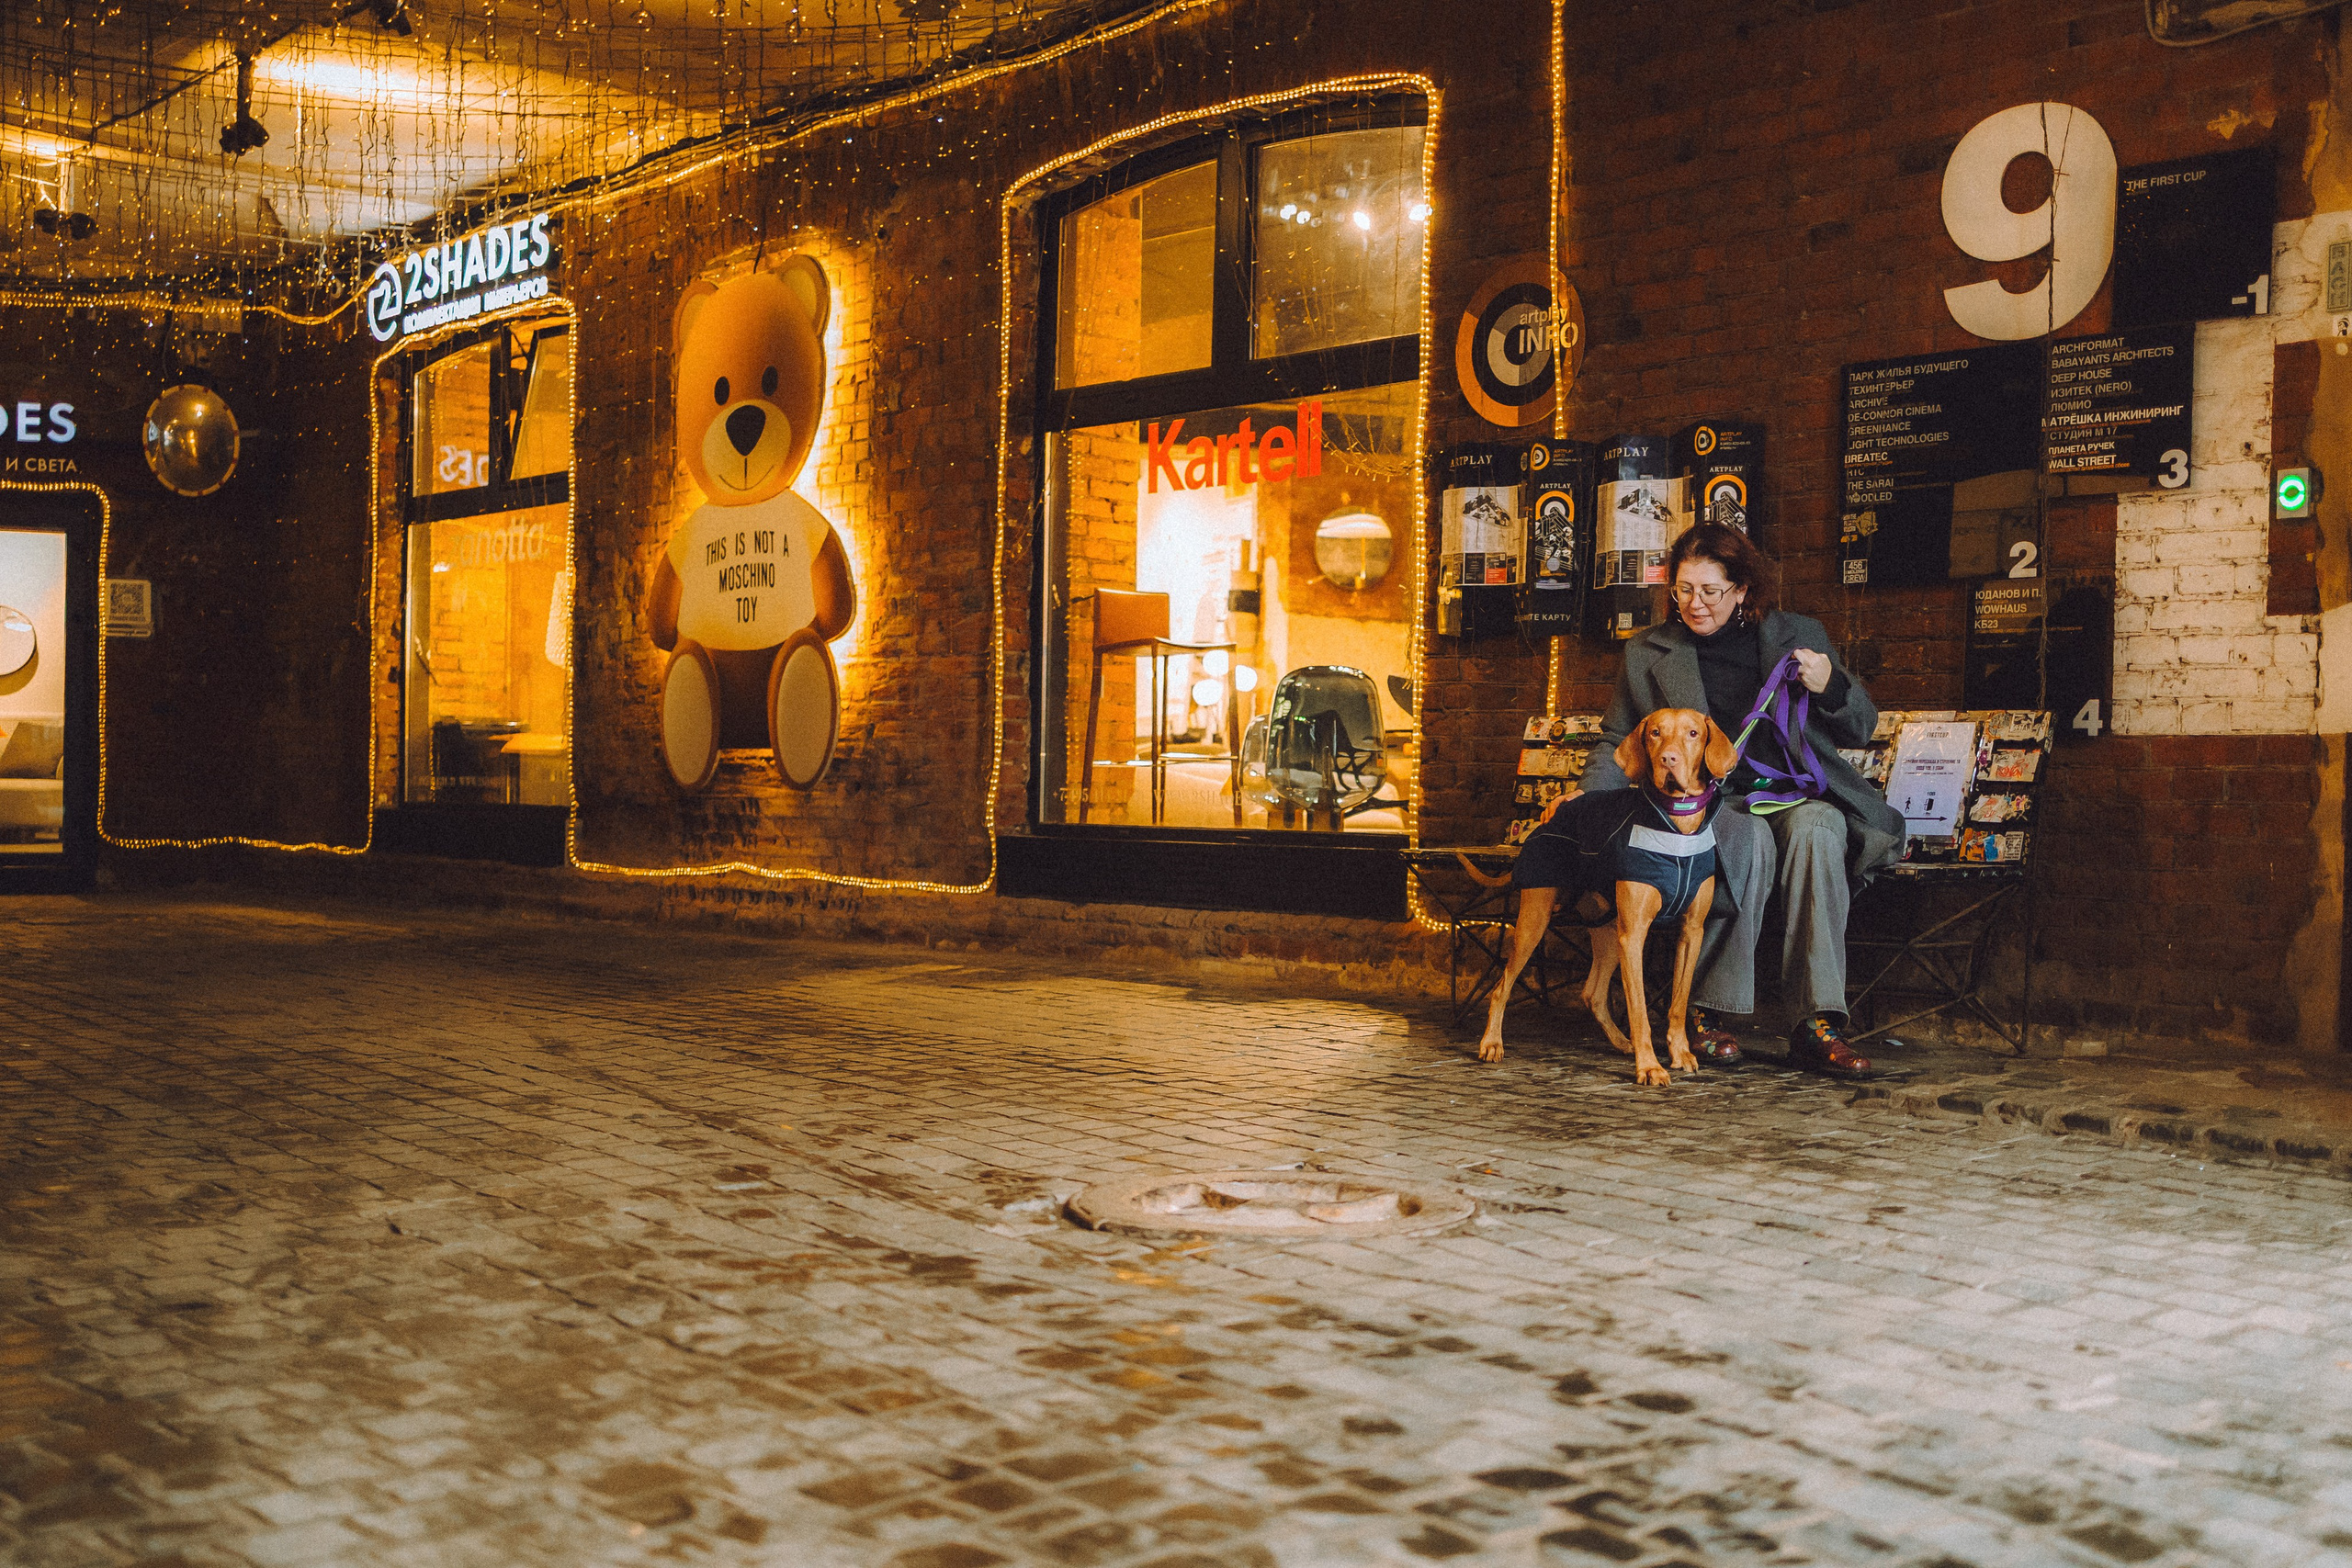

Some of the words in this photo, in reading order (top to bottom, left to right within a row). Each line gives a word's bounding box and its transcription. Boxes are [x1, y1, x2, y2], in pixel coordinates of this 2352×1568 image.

[2126, 178, 2148, 190] THE
[2150, 173, 2181, 187] FIRST
[2183, 170, 2206, 183] CUP
[1941, 102, 2118, 341] 9
[404, 212, 550, 305] 2SHADES
[1520, 306, 1568, 326] artply
[2052, 337, 2125, 355] ARCHFORMAT
[2052, 354, 2110, 369] BABAYANTS
[2112, 346, 2175, 362] ARCHITECTS
[1849, 371, 1874, 382] ПАРК
[1875, 366, 1912, 379] ЖИЛЬЯ
[1914, 359, 1969, 375] БУДУЩЕГО
[2052, 372, 2076, 384] DEEP
[2078, 368, 2112, 381] HOUSE
[1849, 379, 1915, 395] ТЕХИНТЕРЬЕР
[2051, 385, 2093, 399] ИЗИТЕК
[2095, 381, 2132, 396] (NERO)
[1849, 397, 1889, 410] ARCHIVE
[2051, 400, 2092, 413] ЛЮМИО
[1848, 409, 1904, 423] DE-CONNOR
[1905, 404, 1942, 416] CINEMA
[2104, 405, 2184, 422] ИНЖИНИРИНГ
[1848, 422, 1912, 436] GREENHANCE
[2050, 429, 2093, 441] СТУДИЯ
[1147, 400, 1323, 494] Kartell
[1875, 432, 1950, 446] TECHNOLOGIES
[1604, 446, 1650, 461] ARTPLAY
[2048, 444, 2086, 455] ПЛАНЕТА
[2087, 441, 2115, 451] РУЧЕК
[6, 457, 19, 472] И
[1449, 454, 1493, 468] ARTPLAY
[1709, 465, 1744, 473] ARTPLAY
[2048, 457, 2076, 469] WALL
[2077, 455, 2117, 468] STREET
[2158, 449, 2188, 489] 3
[1848, 480, 1864, 491] THE
[1865, 478, 1894, 489] SARAI
[706, 537, 727, 567] THIS
[735, 533, 746, 557] IS
[754, 530, 775, 554] NOT
[783, 534, 790, 558] A
[2008, 541, 2038, 579] 2
[718, 562, 775, 593] MOSCHINO
[1975, 589, 2020, 600] ЮДАНОВ
[2021, 589, 2030, 598] И
[735, 597, 758, 624] TOY
[1974, 603, 2028, 615] WOWHAUS
[1542, 614, 1571, 622] КАРТУ
[1973, 619, 1999, 629] КБ23
[2072, 698, 2103, 736] 4
